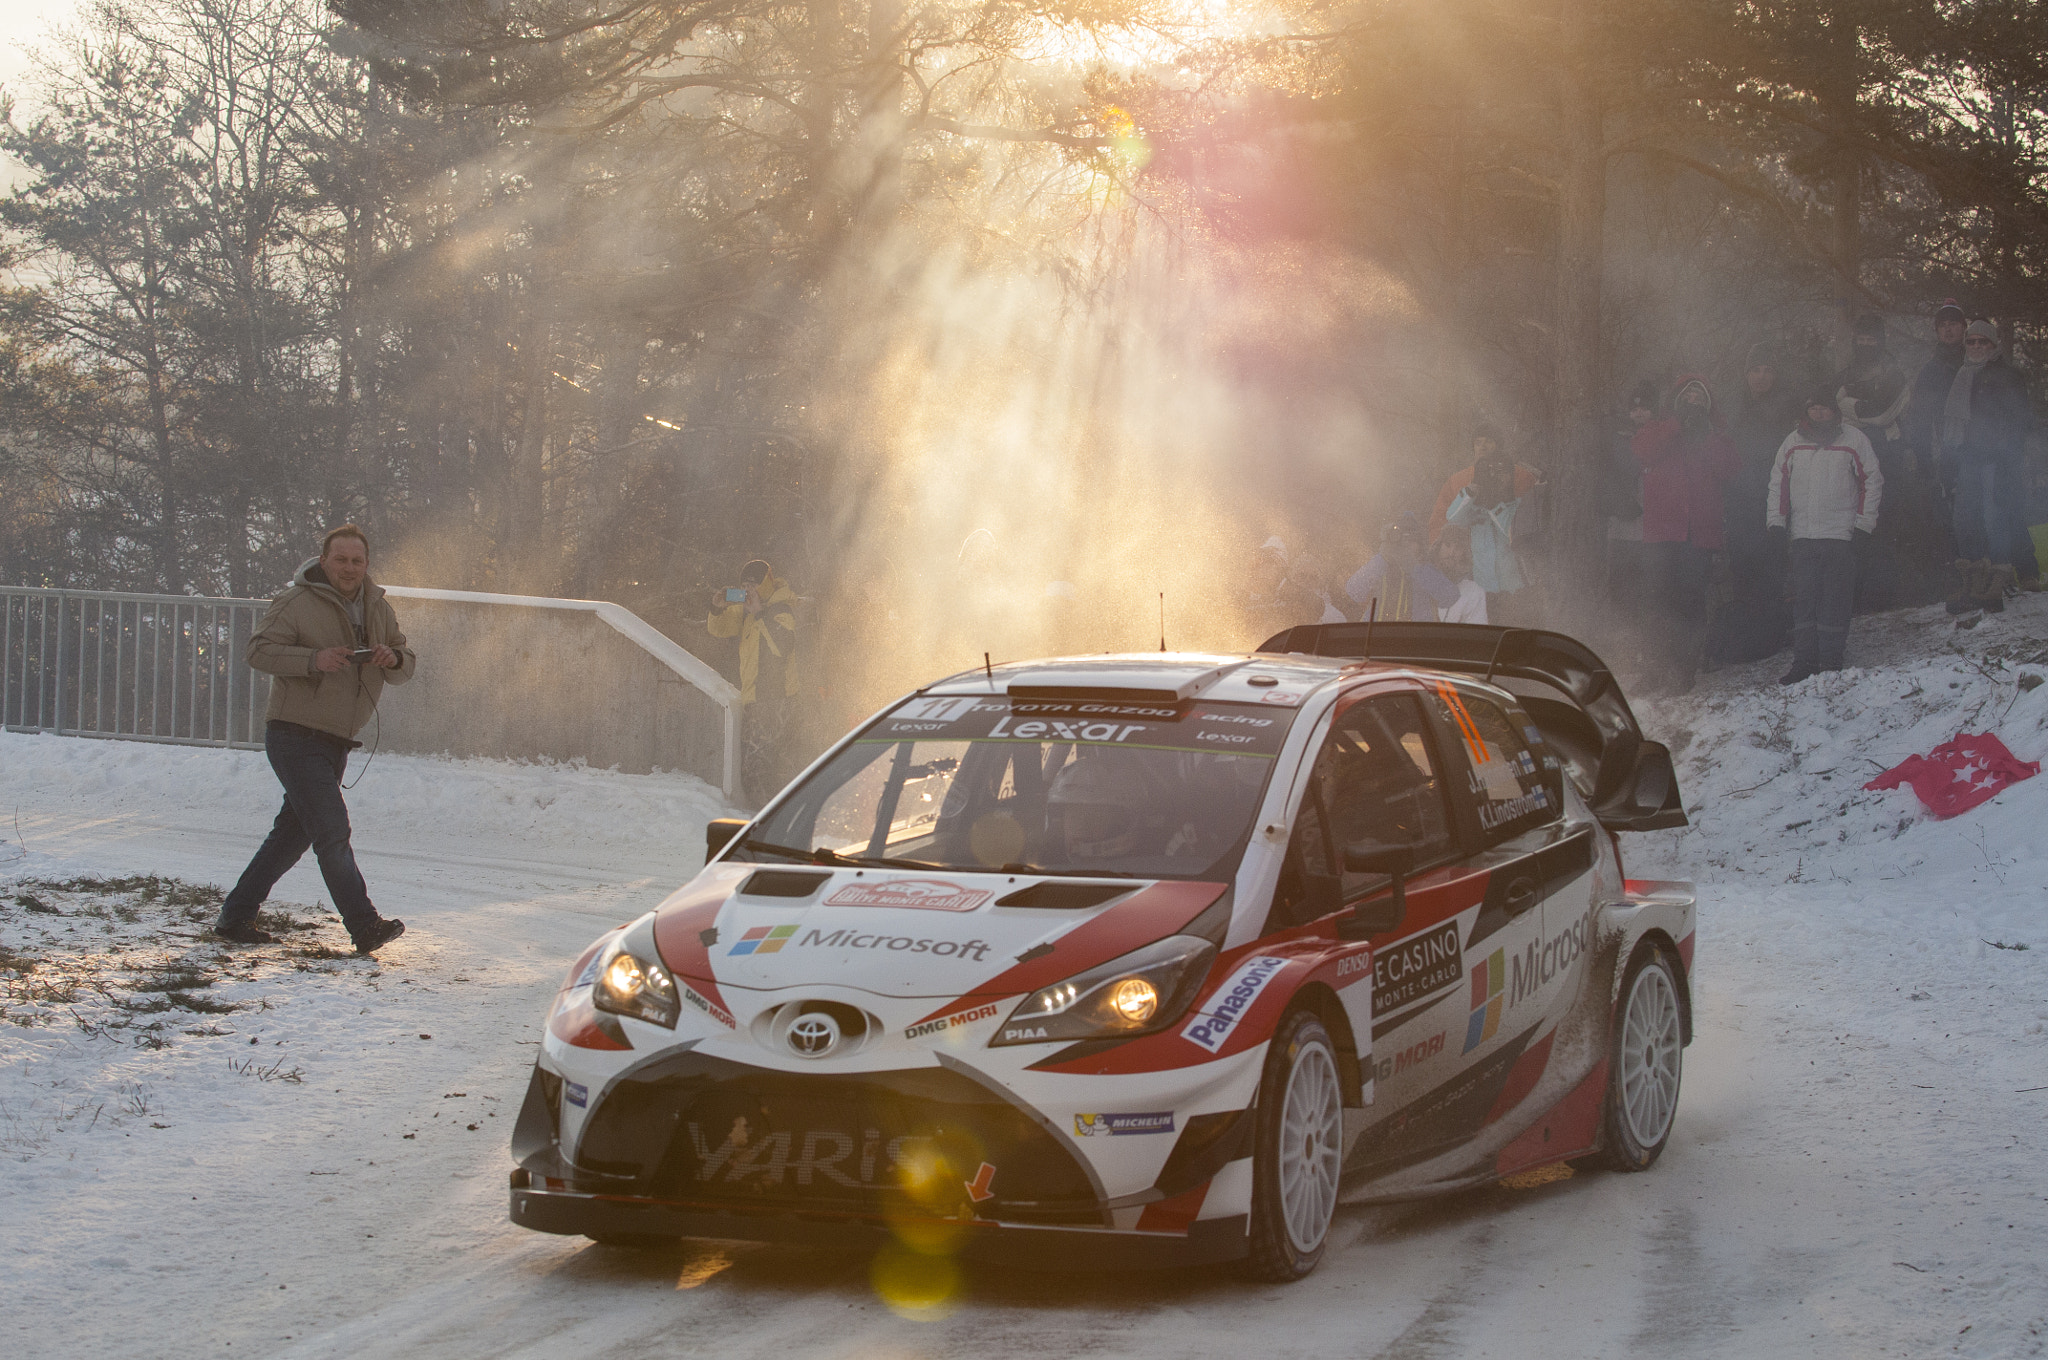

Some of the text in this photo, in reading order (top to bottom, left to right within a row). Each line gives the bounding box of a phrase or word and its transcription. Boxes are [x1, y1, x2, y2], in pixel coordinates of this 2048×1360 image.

[916, 698, 964, 719] 11
[971, 703, 1072, 712] TOYOTA
[1077, 703, 1177, 717] GAZOO
[890, 721, 949, 732] Lexar
[987, 715, 1147, 742] Lexar
[1196, 730, 1257, 744] Lexar
[799, 928, 992, 962] Microsoft
[1388, 929, 1457, 981] CASINO
[1337, 951, 1369, 977] DENSO
[685, 988, 736, 1031] DMG MORI
[1187, 958, 1283, 1047] Panasonic
[904, 1004, 998, 1040] DMG MORI
[1004, 1027, 1048, 1040] PIAA
[1394, 1030, 1447, 1075] MORI
[1111, 1115, 1172, 1128] MICHELIN
